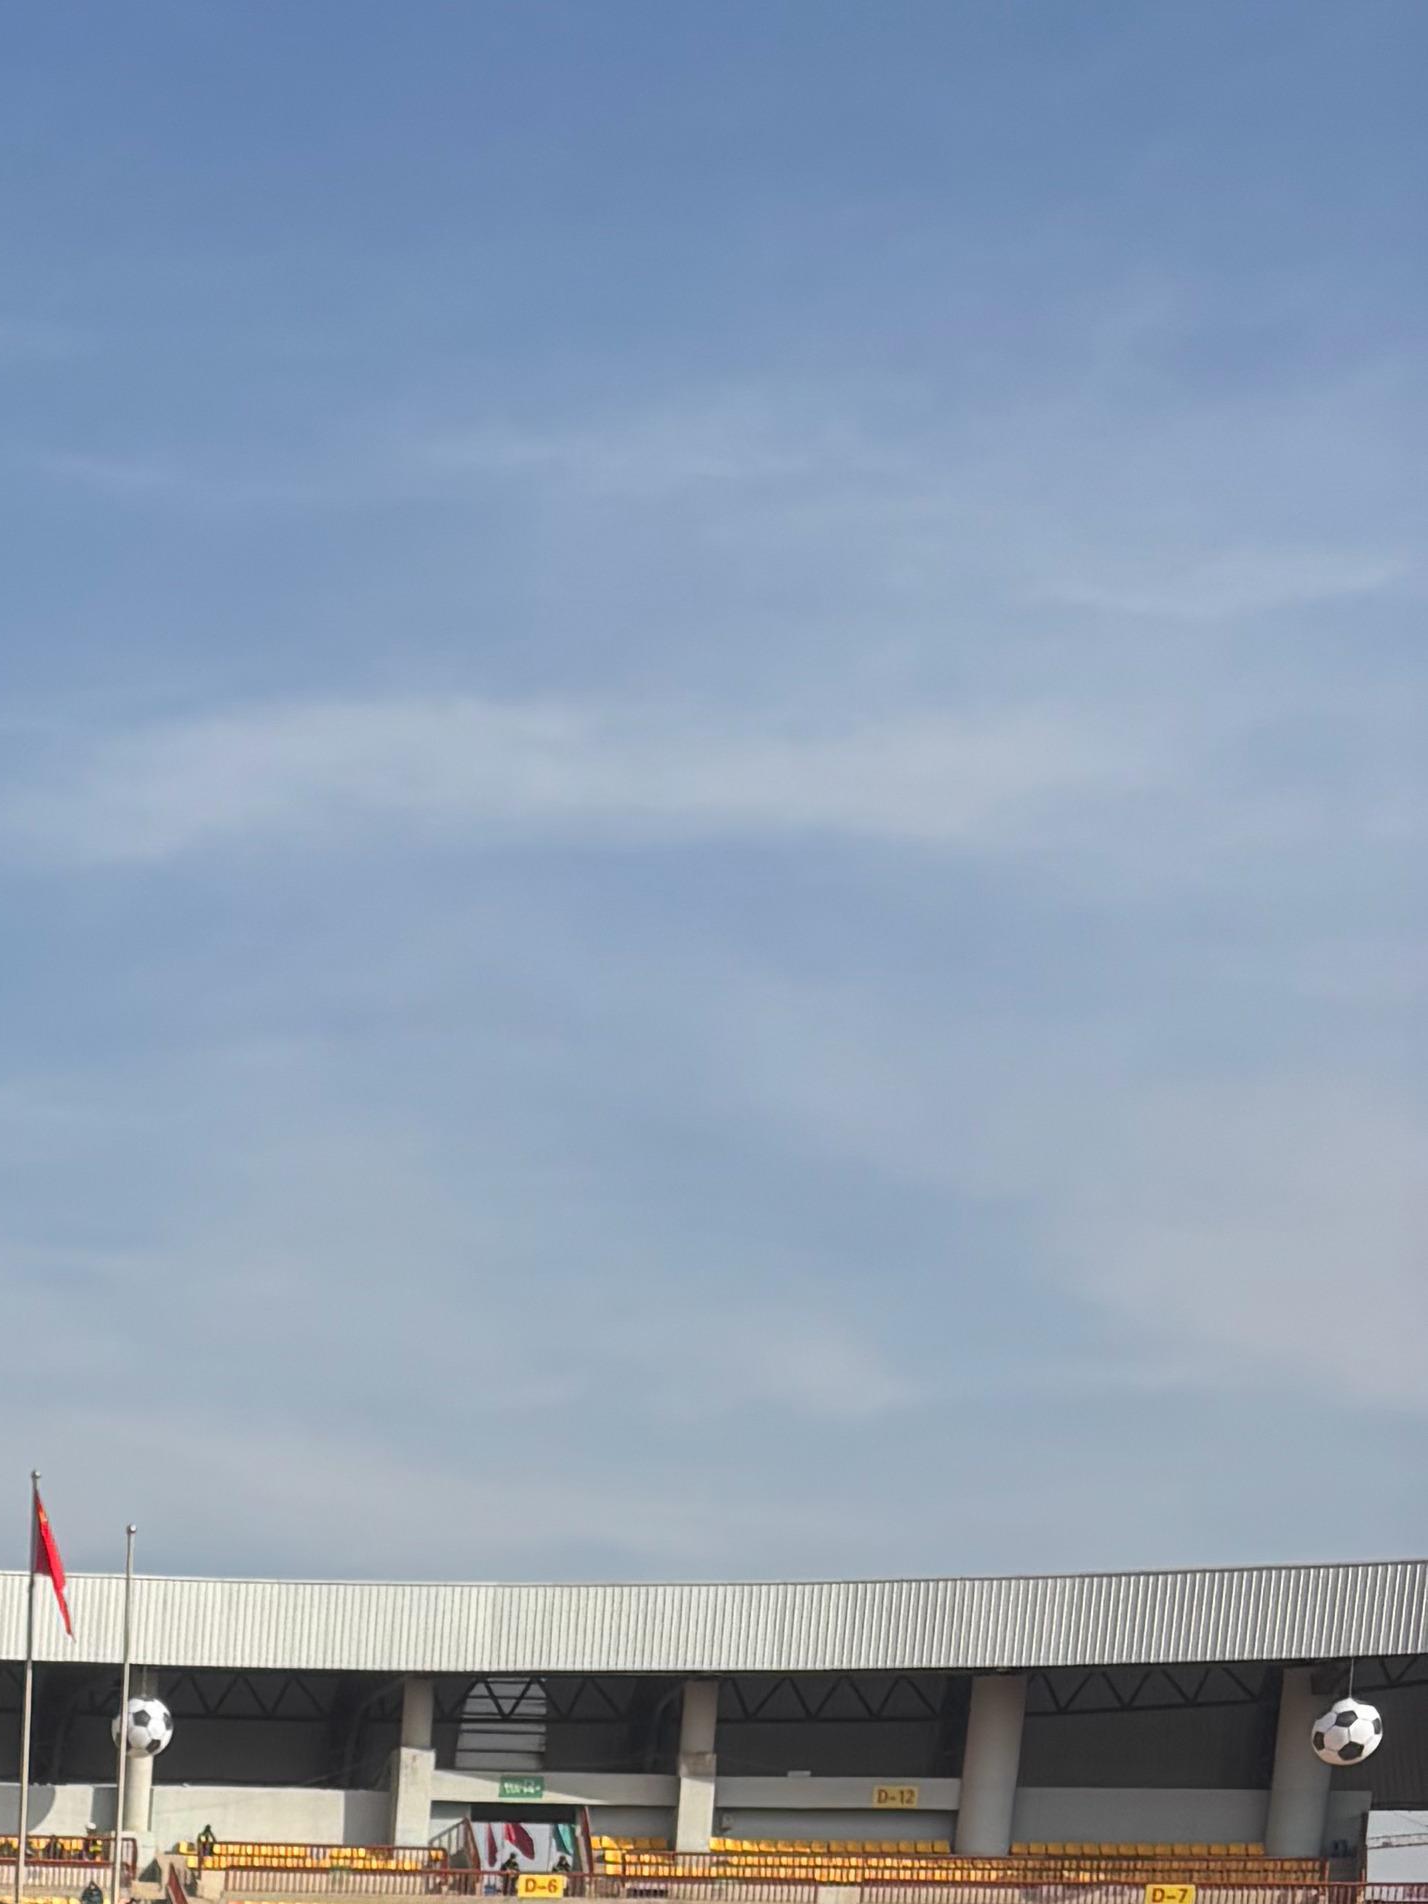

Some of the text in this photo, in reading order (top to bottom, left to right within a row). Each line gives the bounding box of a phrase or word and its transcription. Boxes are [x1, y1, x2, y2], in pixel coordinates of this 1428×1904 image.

[877, 1789, 916, 1806] D-12
[524, 1877, 559, 1893] D-6
[1152, 1887, 1188, 1904] D-7
